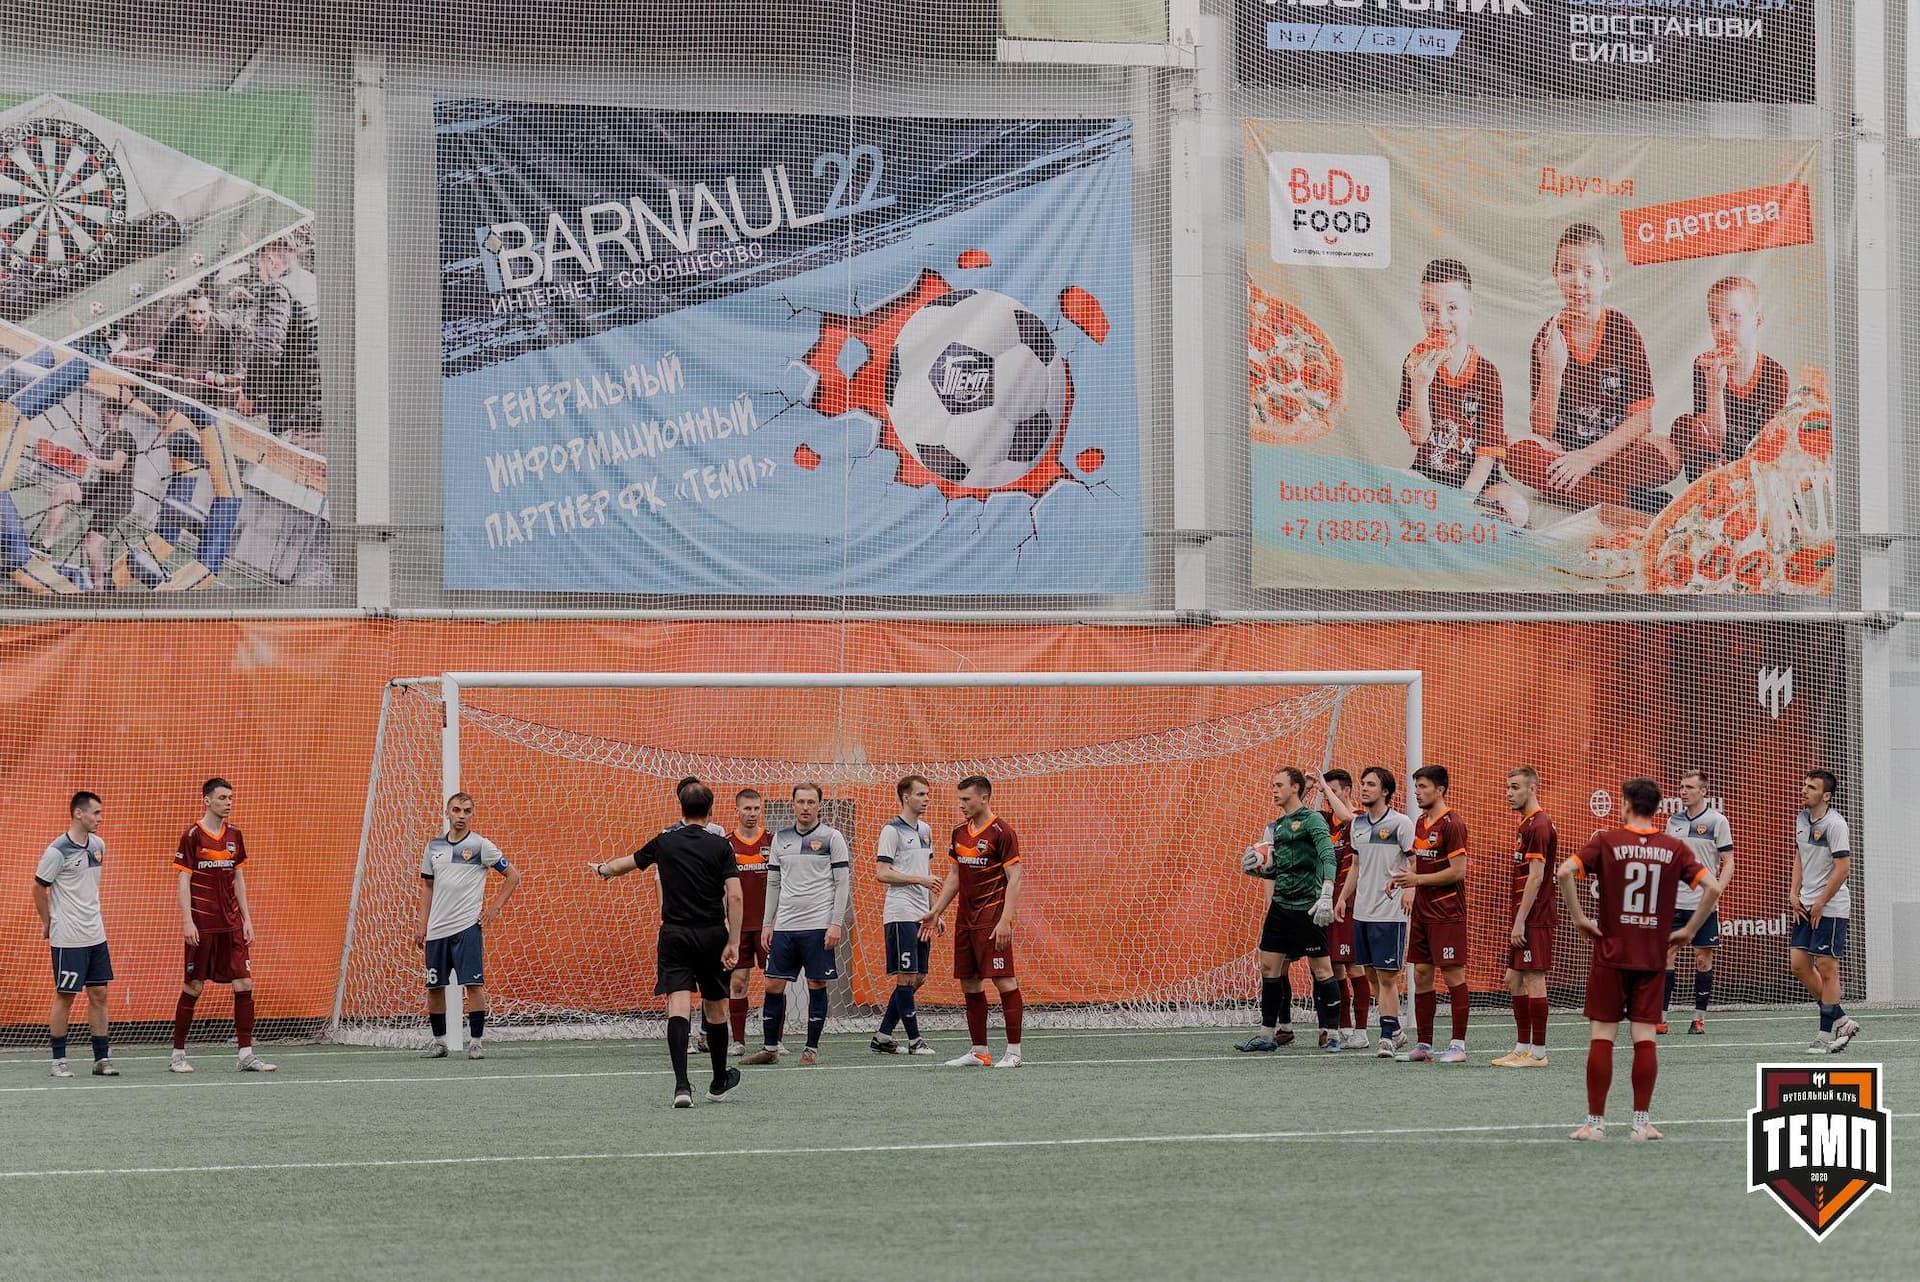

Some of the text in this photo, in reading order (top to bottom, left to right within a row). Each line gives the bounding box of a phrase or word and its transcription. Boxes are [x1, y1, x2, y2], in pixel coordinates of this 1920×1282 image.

[1569, 14, 1763, 38] ВОССТАНОВИ
[1571, 42, 1661, 63] СИЛЫ.
[1288, 167, 1370, 206] BuDu
[1538, 166, 1634, 198] Друзья
[1292, 208, 1371, 234] FOOD
[1638, 200, 1780, 243] с детства
[483, 350, 685, 431] ГЕНЕРАЛЬНЫЙ
[485, 391, 758, 494] ИНФОРМАЦИОННЫЙ
[485, 454, 777, 549] ПАРТНЕР ФК «ТЕМП»
[1279, 480, 1438, 511] budufood.org
[1281, 518, 1497, 547] +7 (3852) 22-66-01
[1623, 861, 1662, 914] 21
[1620, 914, 1659, 926] SEUS
[1717, 912, 1787, 937] arnaul
[901, 951, 912, 969] 5
[992, 957, 1005, 969] 55
[1442, 946, 1455, 960] 22
[60, 970, 79, 989] 77
